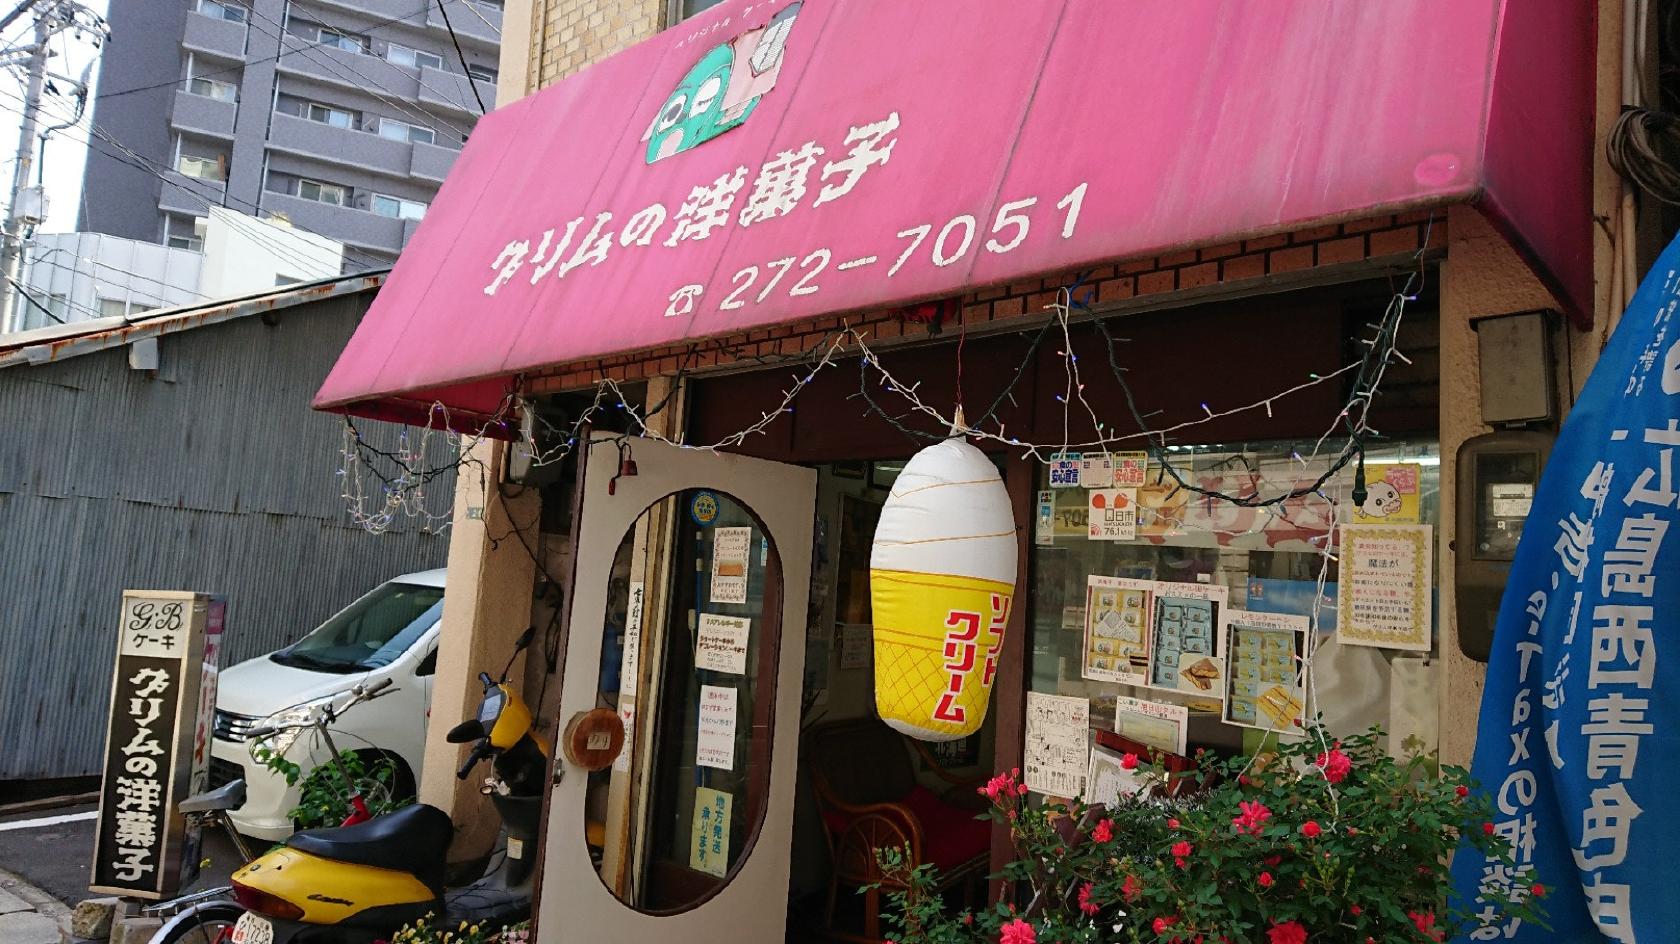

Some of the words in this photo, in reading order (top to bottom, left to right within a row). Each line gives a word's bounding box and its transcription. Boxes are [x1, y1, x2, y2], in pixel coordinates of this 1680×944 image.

[484, 112, 900, 296] グリムの洋菓子
[720, 183, 1088, 310] 272-7051
[1368, 559, 1399, 568] 魔法が
[133, 634, 175, 650] ケーキ
[932, 610, 981, 725] クリーム
[982, 593, 1010, 687] ソフト
[112, 667, 172, 882] グリムの洋菓子
[713, 794, 725, 854] 地方発送
